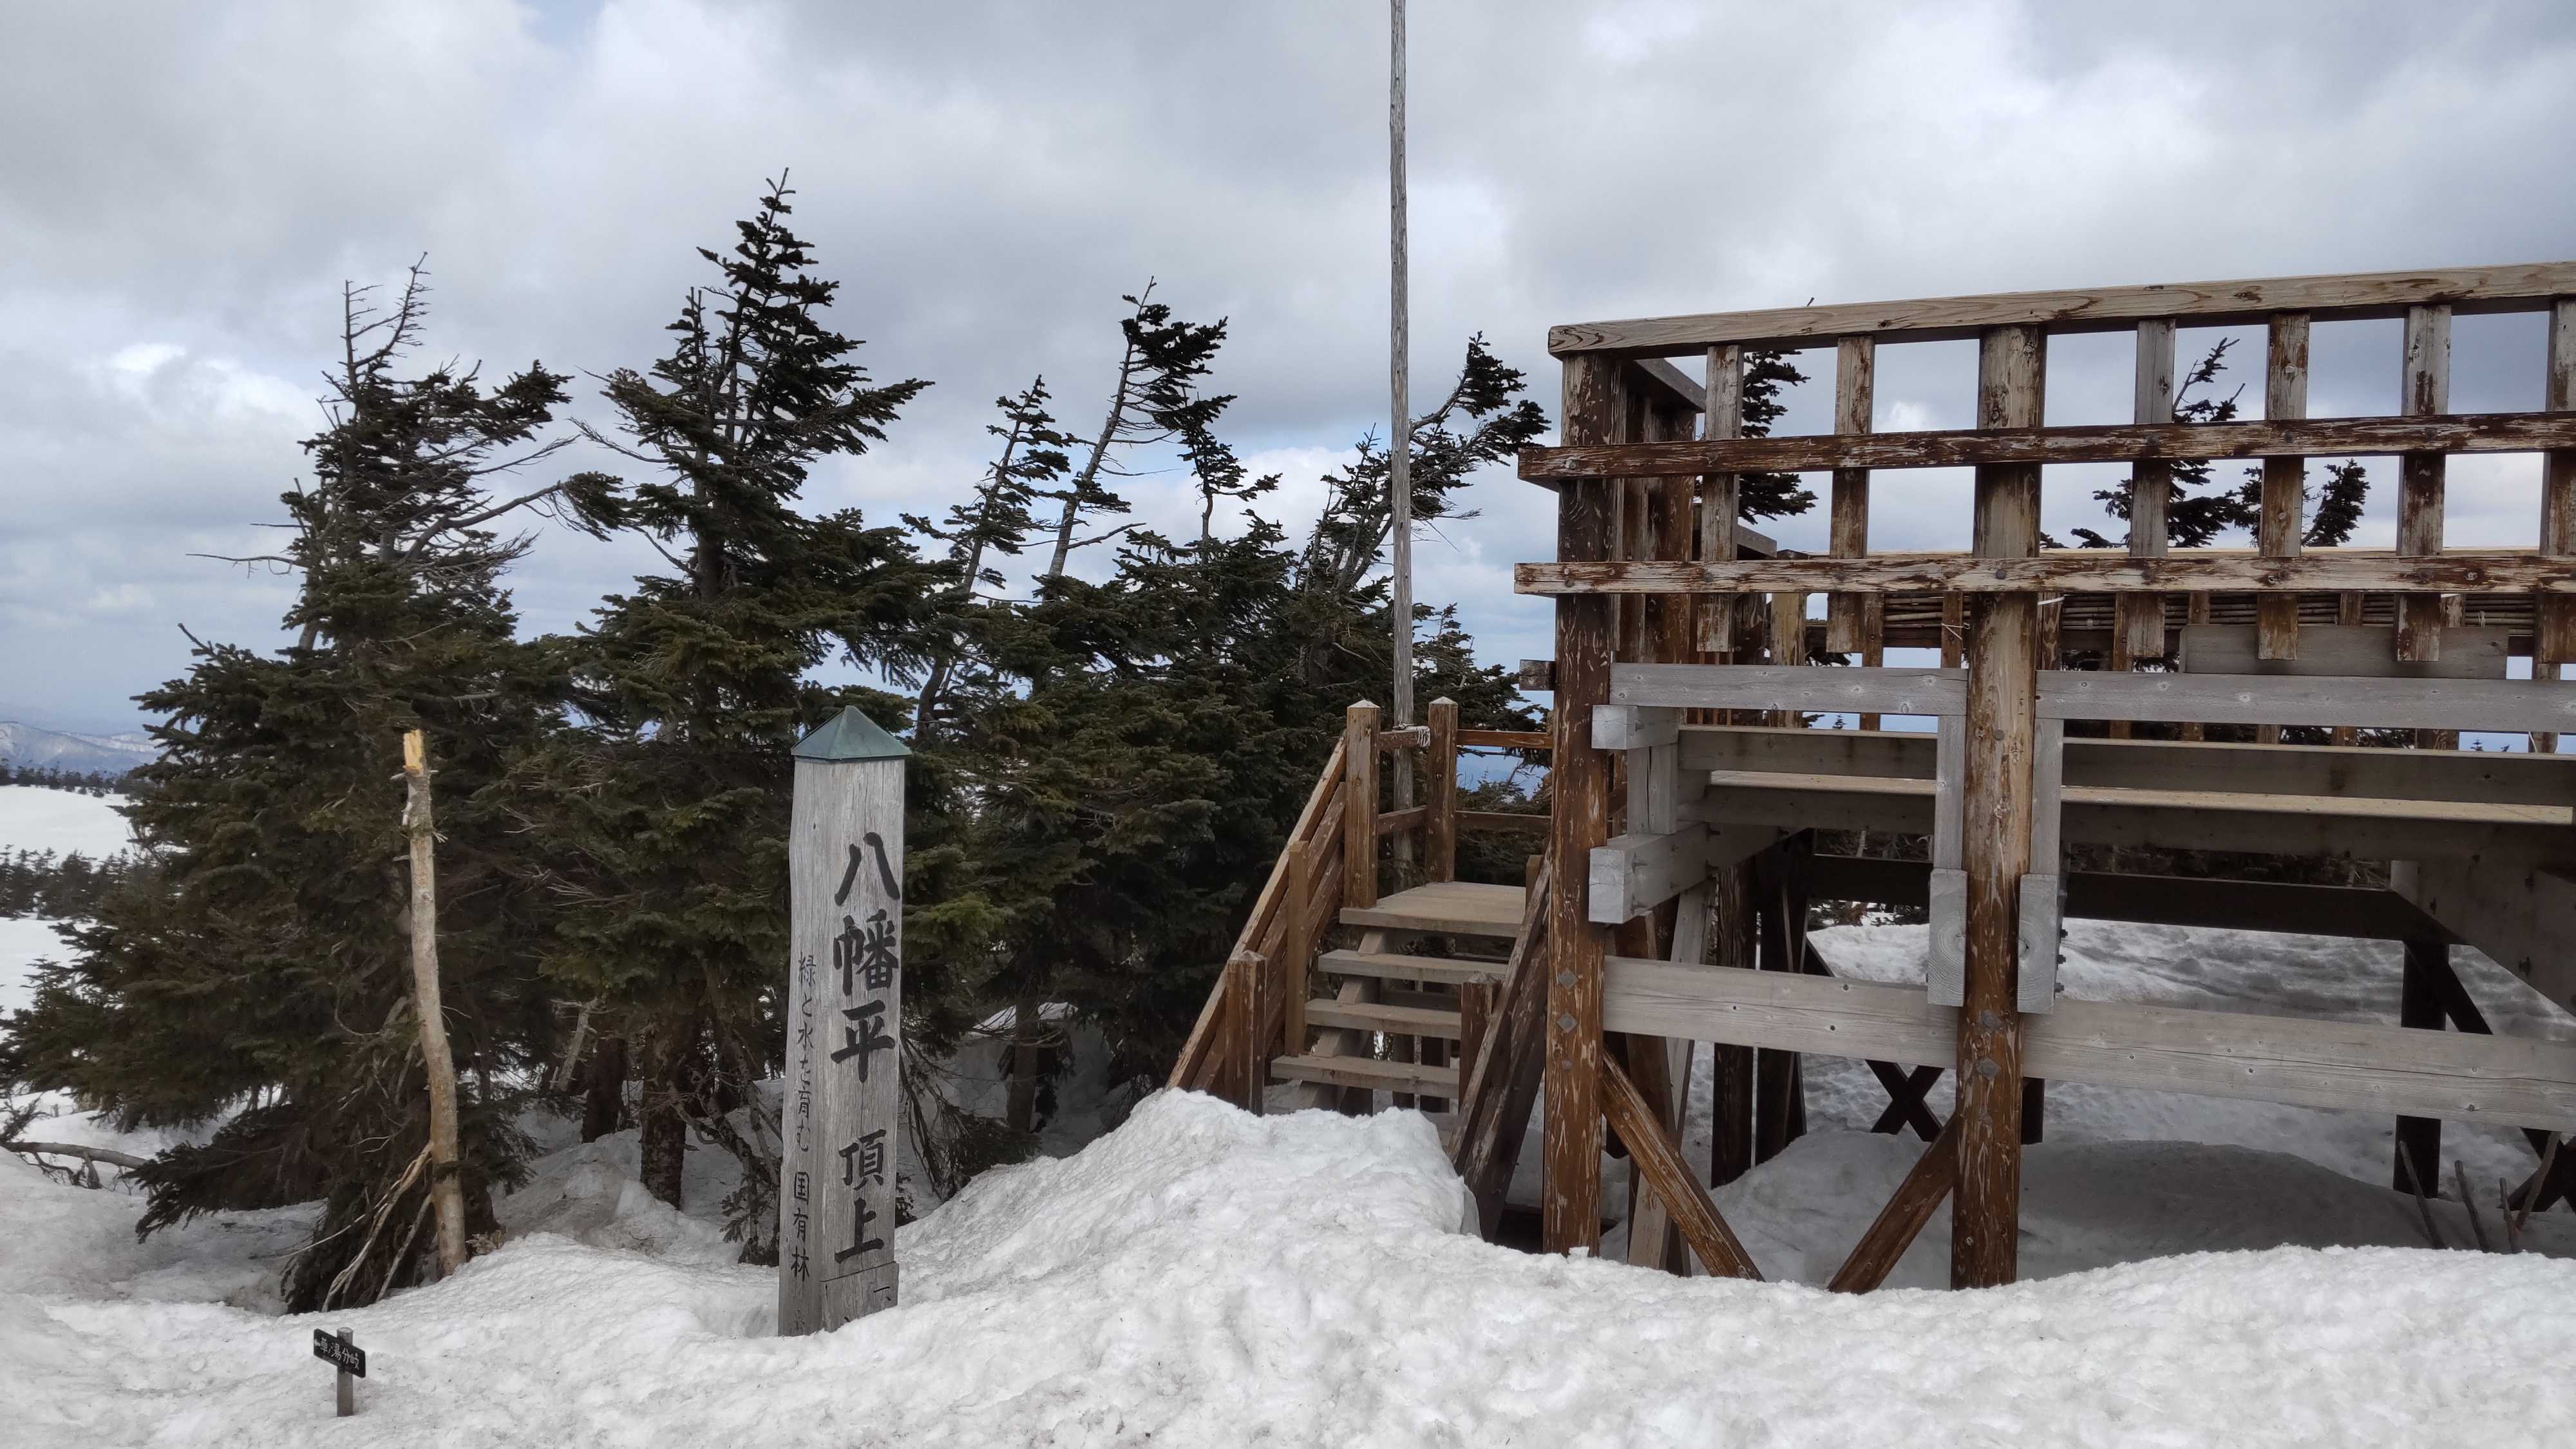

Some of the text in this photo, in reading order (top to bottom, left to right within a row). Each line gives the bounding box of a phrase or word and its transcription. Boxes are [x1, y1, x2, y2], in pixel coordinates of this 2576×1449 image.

[790, 951, 817, 1282] 緑と水を育む 国有林
[830, 831, 900, 1264] 八幡平 頂上
